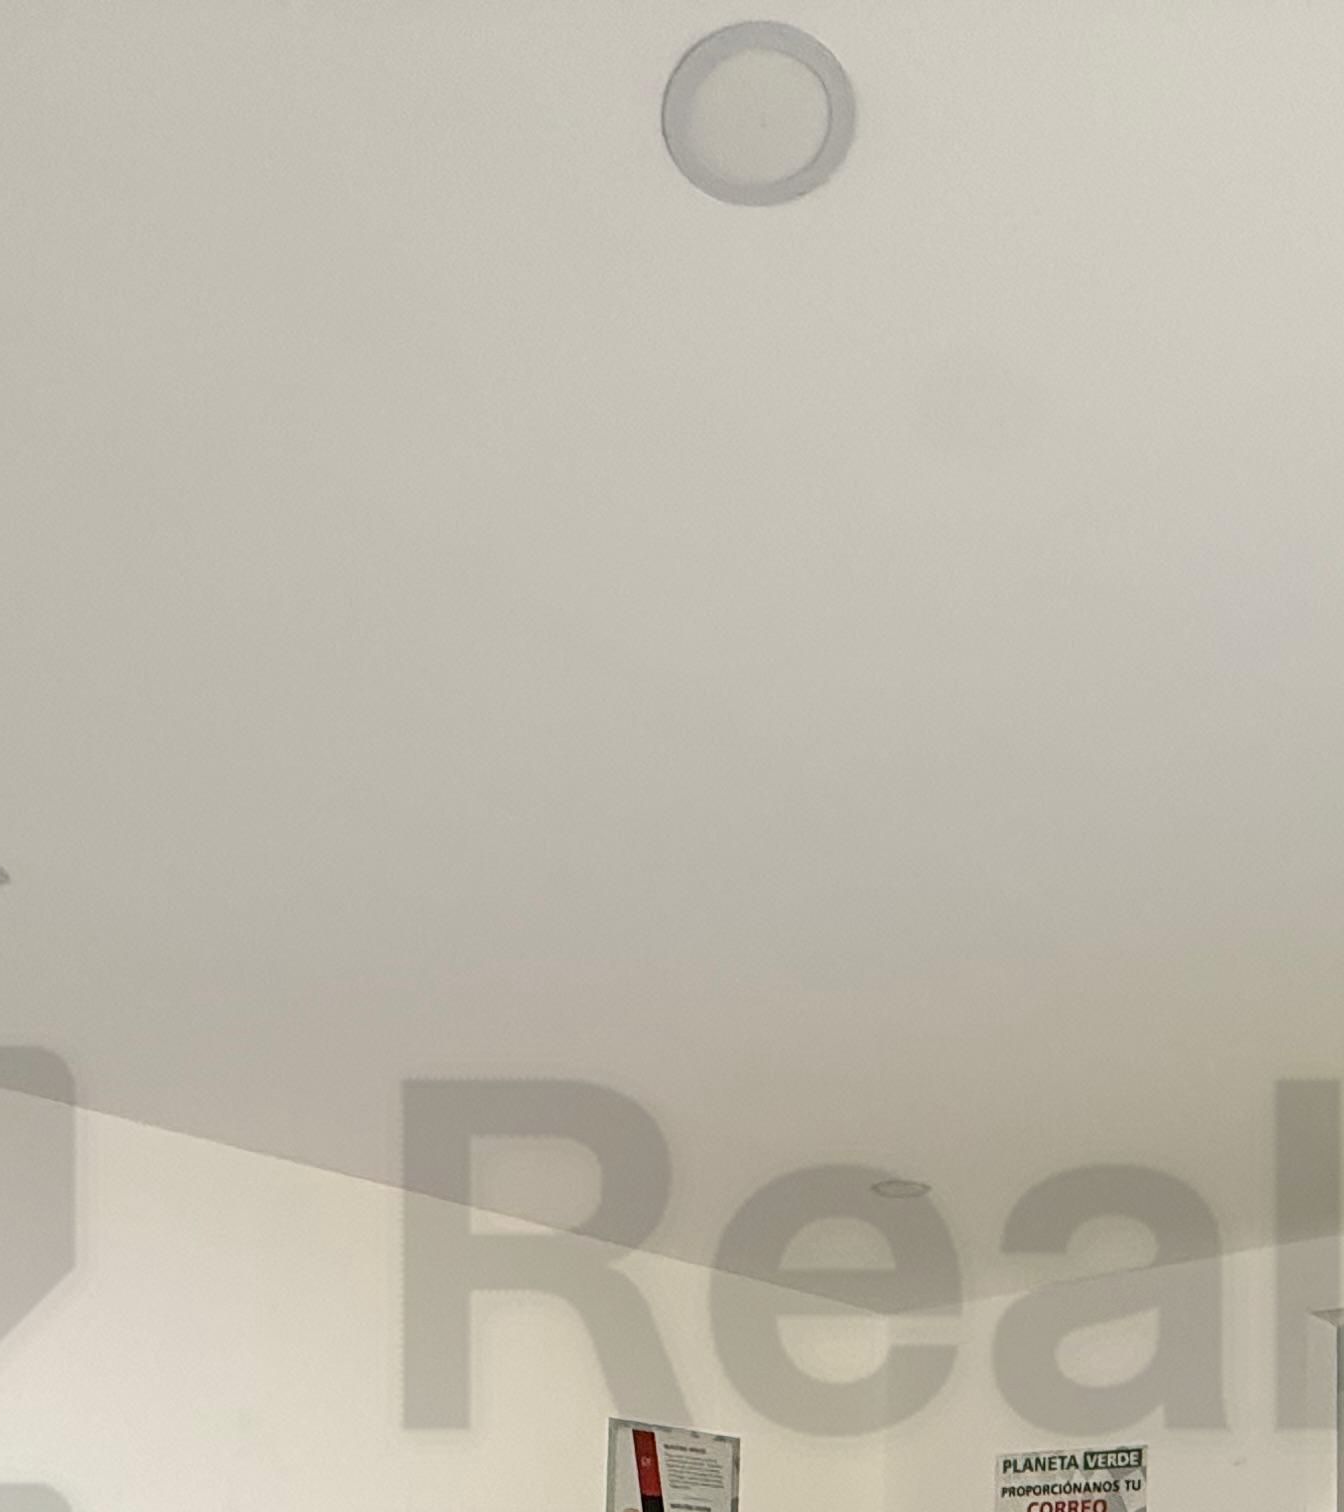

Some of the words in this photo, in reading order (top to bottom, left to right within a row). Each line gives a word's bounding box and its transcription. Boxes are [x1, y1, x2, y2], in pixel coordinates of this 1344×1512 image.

[1002, 1455, 1079, 1474] PLANETA
[1086, 1450, 1140, 1470] VERDE
[1001, 1478, 1120, 1498] PROPORCIÓNANOS
[1124, 1479, 1142, 1492] TU
